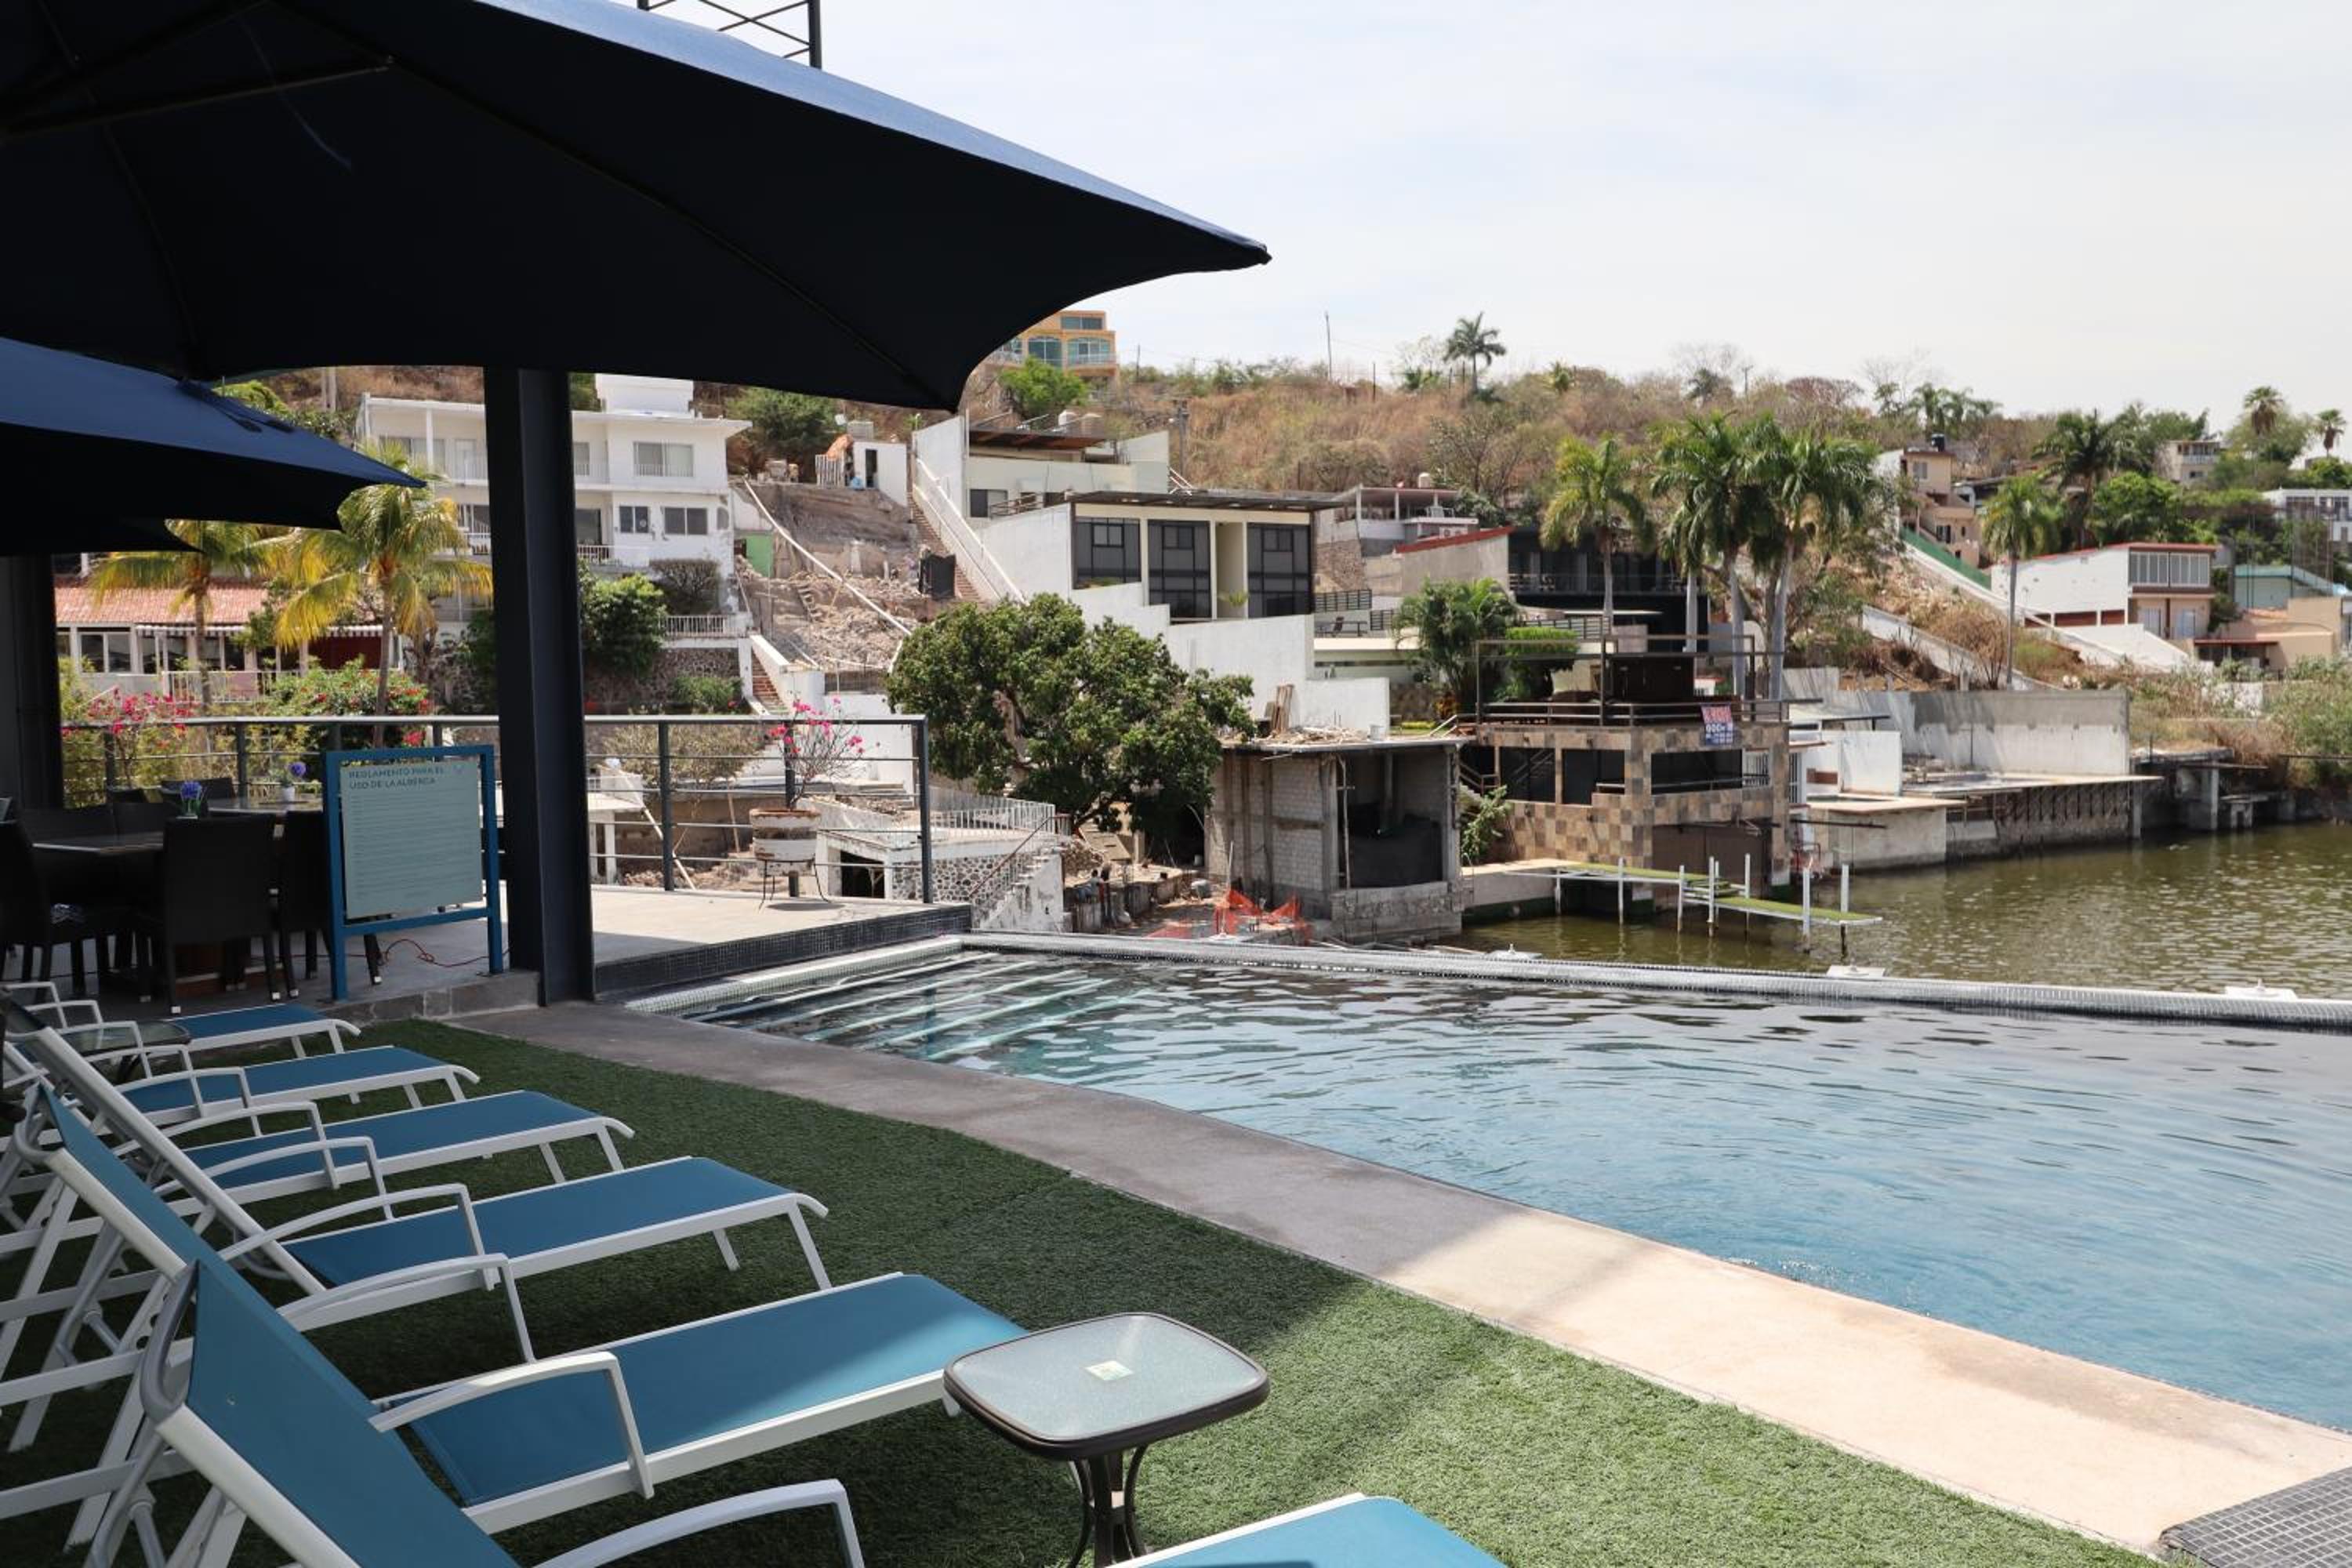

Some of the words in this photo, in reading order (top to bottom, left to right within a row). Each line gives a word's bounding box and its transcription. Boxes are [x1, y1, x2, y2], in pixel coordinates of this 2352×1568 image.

[349, 768, 409, 779] REGLAMENTO
[350, 780, 369, 789] USO
[371, 779, 382, 788] DE
[385, 779, 396, 788] LA
[396, 777, 435, 786] ALBERCA
